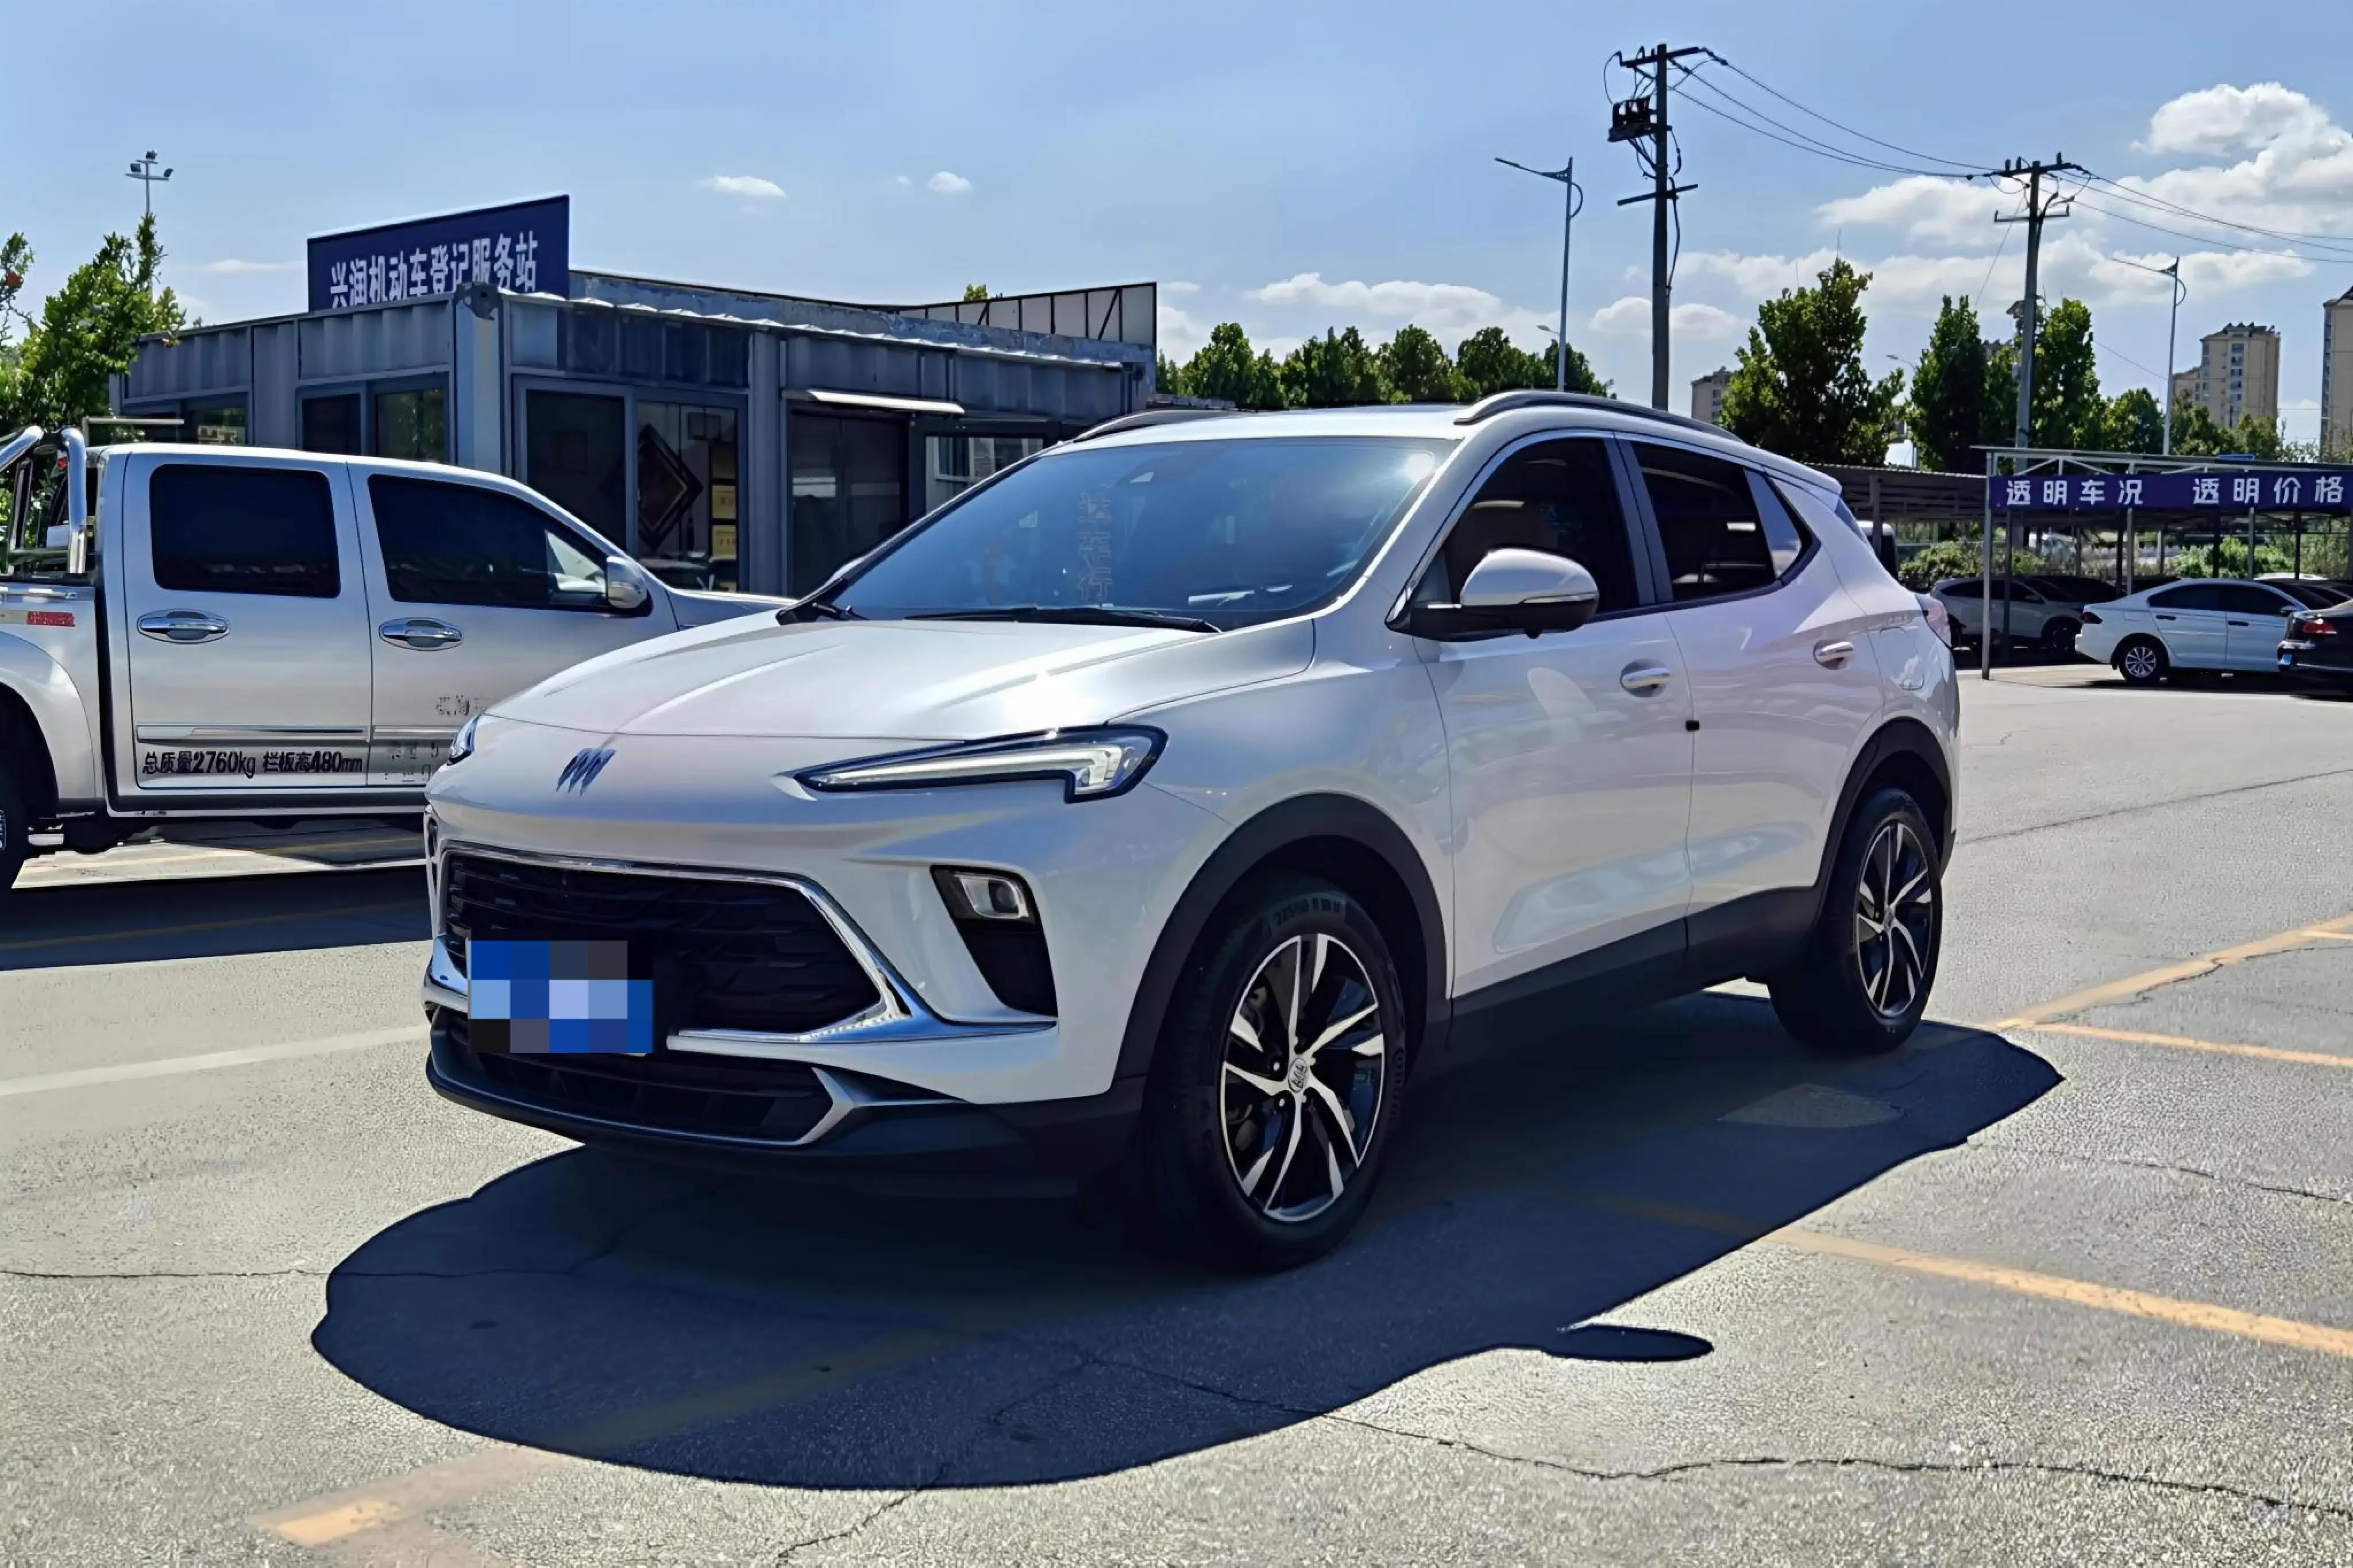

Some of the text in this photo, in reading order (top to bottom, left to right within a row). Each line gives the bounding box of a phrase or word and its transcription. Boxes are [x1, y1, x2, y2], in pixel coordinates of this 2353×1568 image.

[329, 230, 538, 308] 兴润机动车登记服务站
[2006, 476, 2344, 506] 透明车况 透明价格
[142, 751, 362, 779] 总质量2760kg 栏板高480mm
